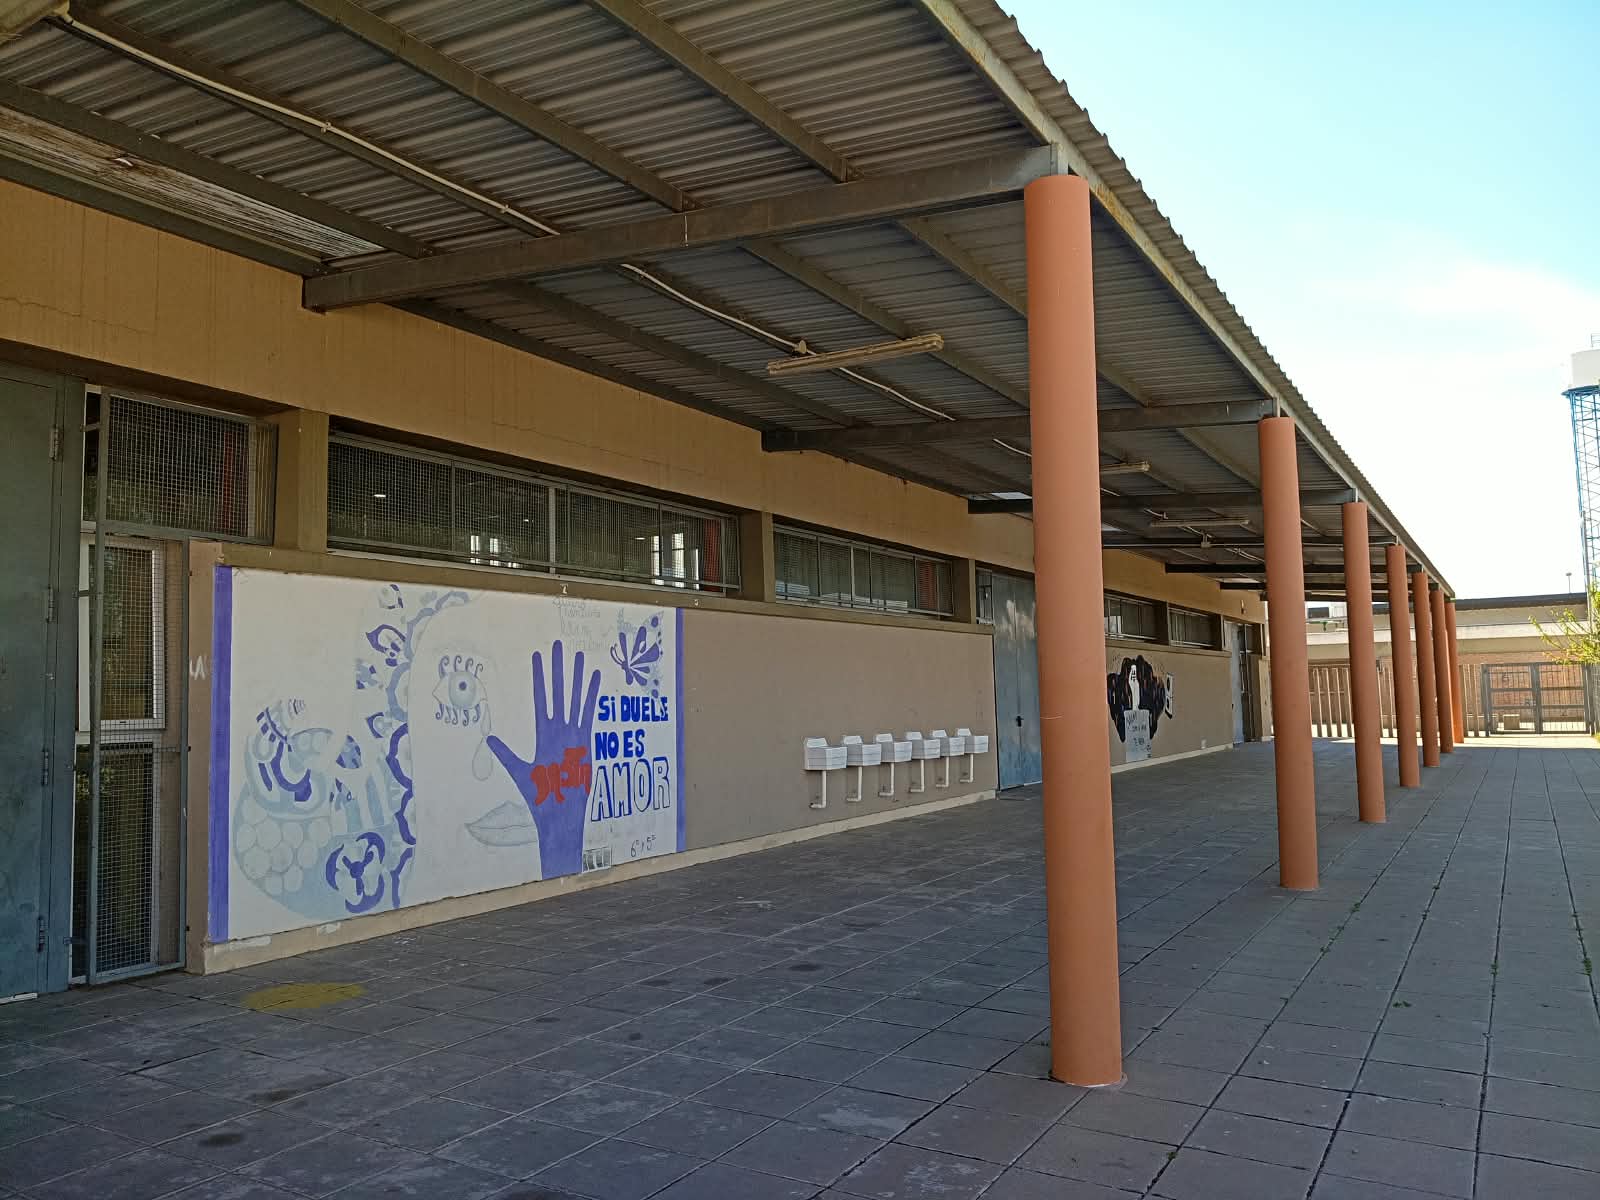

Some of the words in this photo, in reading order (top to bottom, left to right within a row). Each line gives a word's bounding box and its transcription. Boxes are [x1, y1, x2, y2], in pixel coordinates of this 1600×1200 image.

[620, 695, 669, 722] DUELE
[595, 731, 619, 760] NO
[623, 729, 645, 758] ES
[591, 756, 671, 822] AMOR
